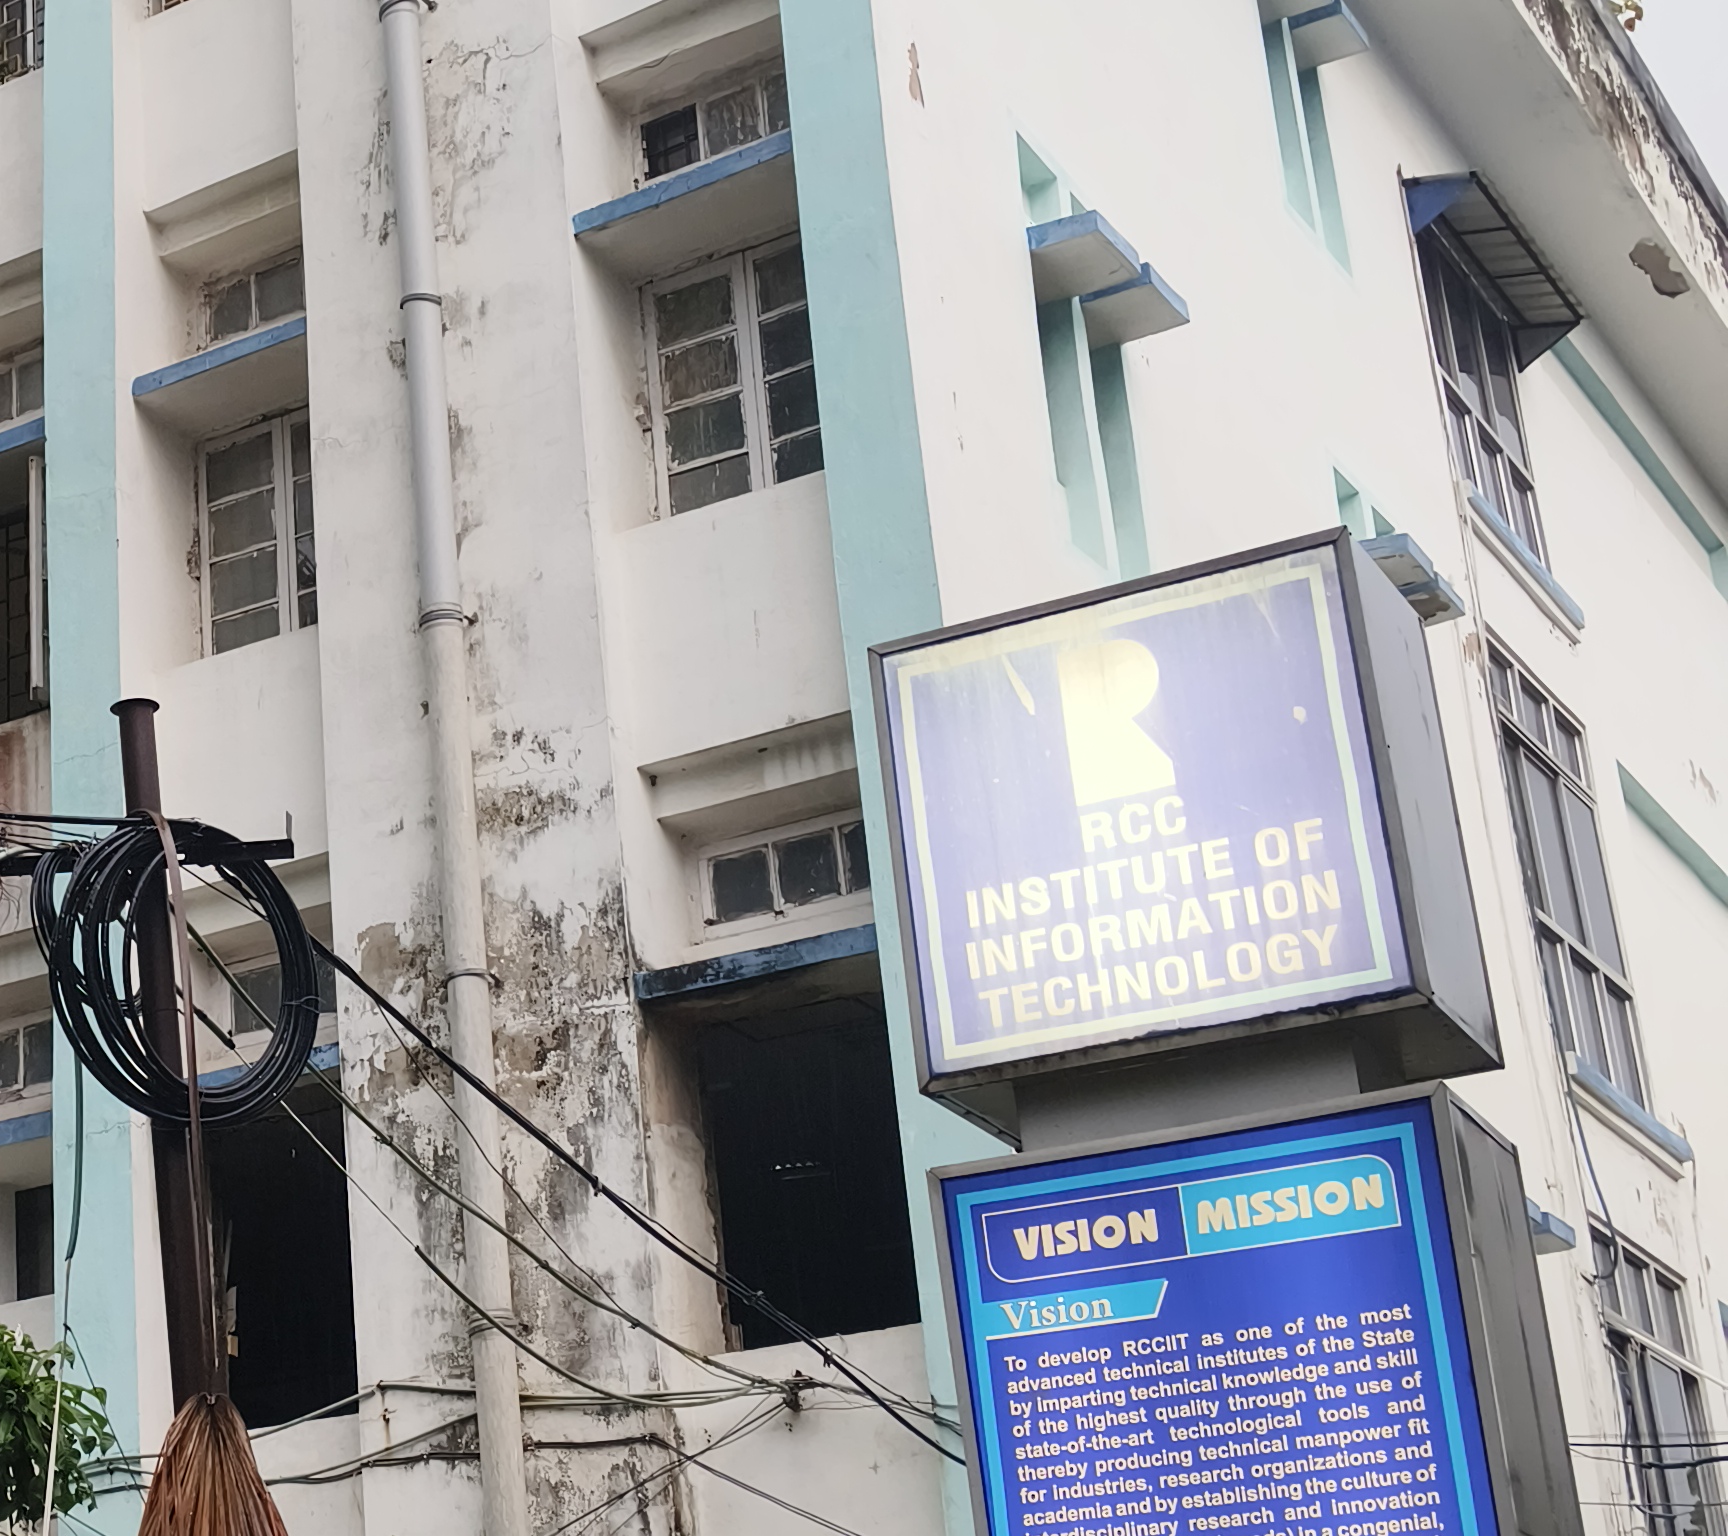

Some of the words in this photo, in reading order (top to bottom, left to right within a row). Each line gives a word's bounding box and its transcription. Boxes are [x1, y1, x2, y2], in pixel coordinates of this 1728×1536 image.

[1080, 795, 1187, 852] RCC
[966, 837, 1234, 928] INSTITUTE
[1254, 817, 1324, 867] OF
[965, 870, 1341, 979] INFORMATION
[978, 924, 1338, 1028] TECHNOLOGY
[1013, 1208, 1159, 1261] VISION
[1197, 1173, 1385, 1235] MISSION
[1000, 1296, 1114, 1331] Vision
[1003, 1355, 1027, 1373] To
[1037, 1346, 1112, 1369] develop
[1122, 1333, 1189, 1358] RCCIIT
[1201, 1332, 1225, 1347] as
[1235, 1325, 1273, 1342] one
[1284, 1316, 1305, 1336] of
[1315, 1313, 1348, 1332] the
[1359, 1303, 1412, 1326] most
[1009, 1399, 1033, 1419] by
[1036, 1388, 1127, 1414] imparting
[1129, 1374, 1218, 1401] technical
[1221, 1362, 1329, 1390] knowledge
[1333, 1354, 1373, 1375] and
[1376, 1347, 1421, 1373] skill
[1015, 1428, 1155, 1460] state-of-the-art
[1169, 1409, 1303, 1442] technological
[1318, 1402, 1371, 1424] tools
[1387, 1394, 1426, 1415] and
[1019, 1487, 1048, 1505] for
[1052, 1476, 1153, 1501] industries,
[1159, 1463, 1245, 1489] research
[1250, 1449, 1388, 1480] organizations
[1394, 1440, 1434, 1461] and
[1188, 1506, 1275, 1532] research
[1284, 1500, 1323, 1521] and
[1331, 1489, 1441, 1516] innovation
